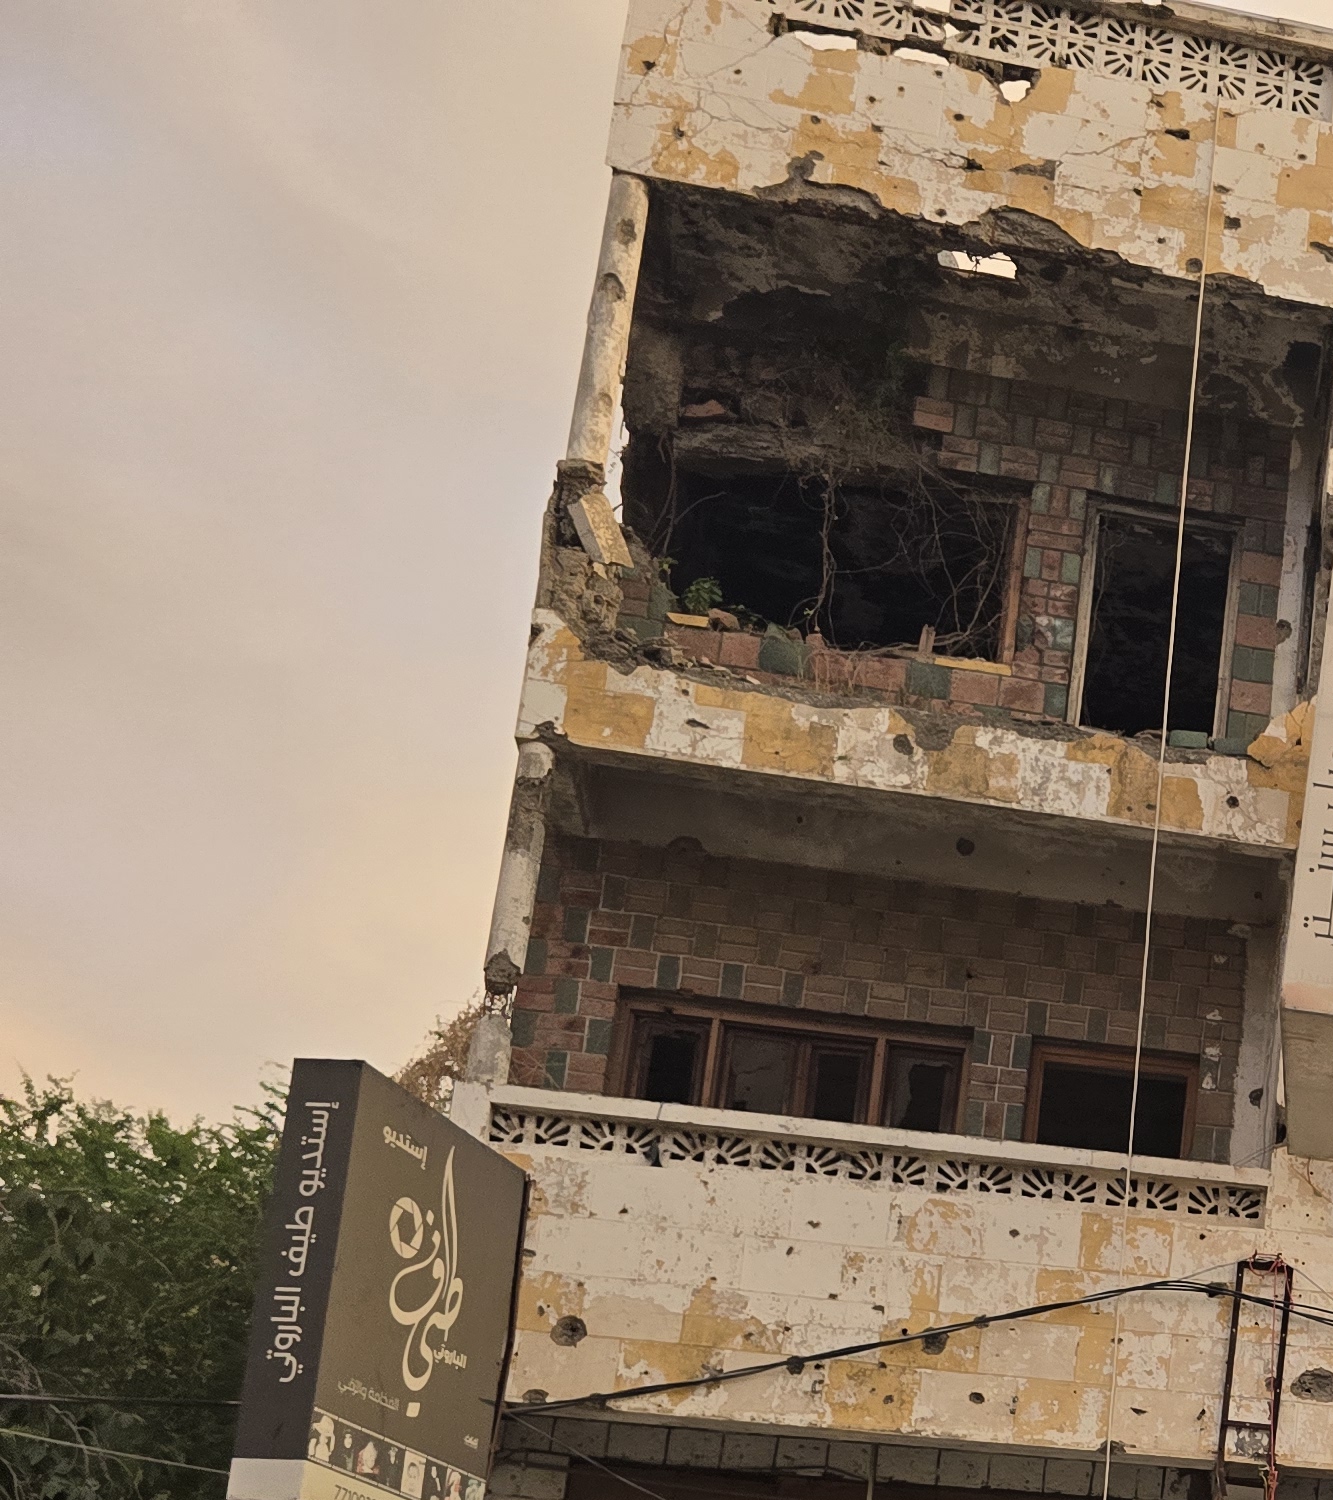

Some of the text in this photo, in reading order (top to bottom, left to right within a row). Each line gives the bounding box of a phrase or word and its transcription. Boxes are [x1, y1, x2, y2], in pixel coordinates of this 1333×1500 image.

[383, 1125, 428, 1170] إستديو
[265, 1101, 340, 1383] إستديو طيف الباروتي
[433, 1340, 468, 1370] الباروتي
